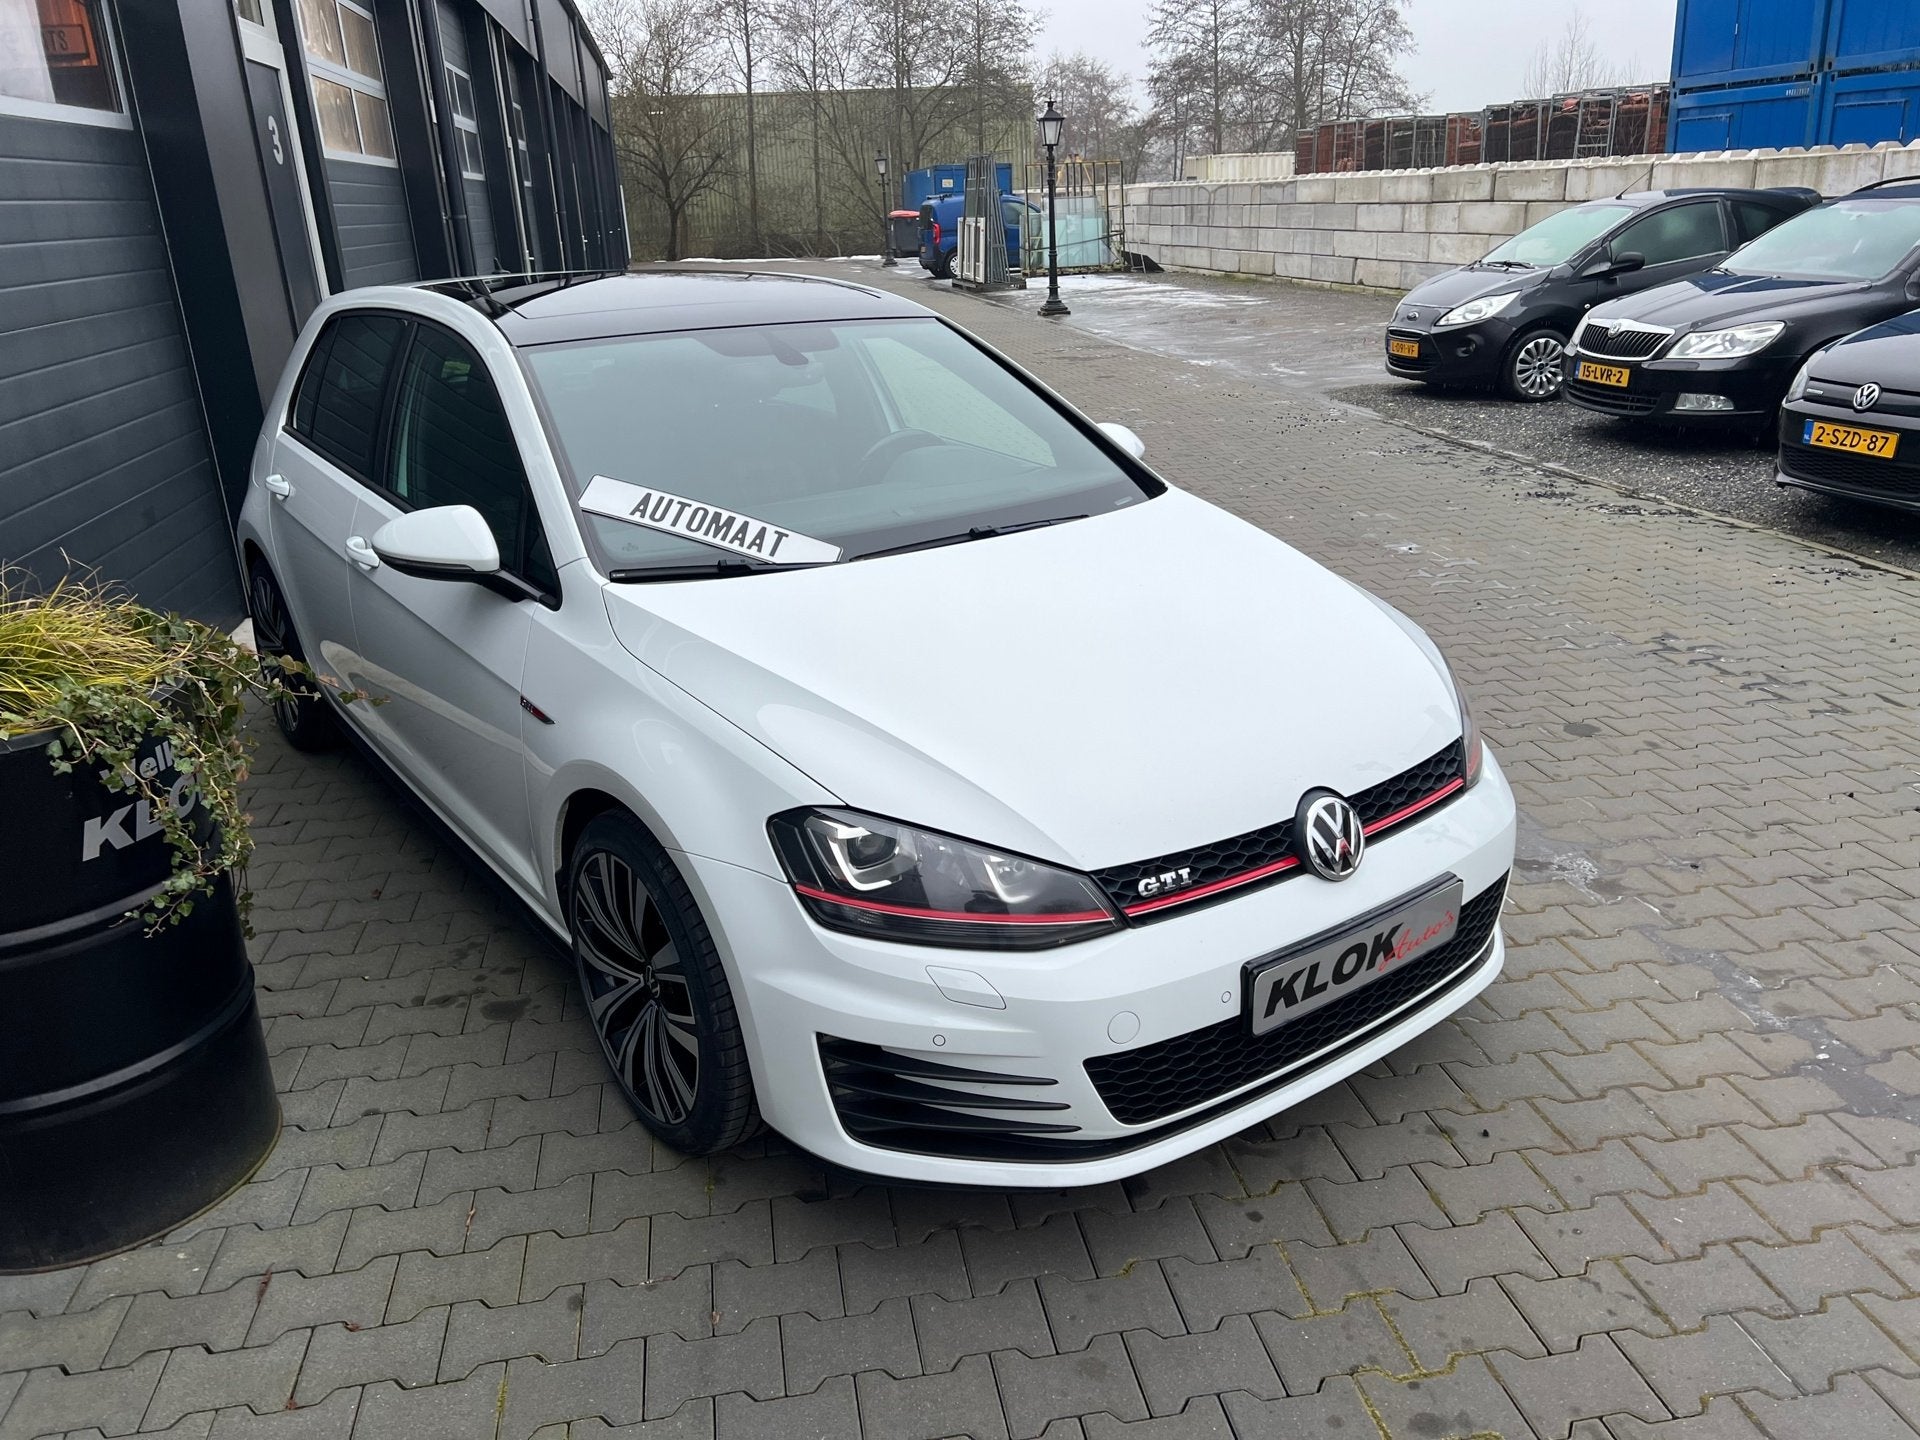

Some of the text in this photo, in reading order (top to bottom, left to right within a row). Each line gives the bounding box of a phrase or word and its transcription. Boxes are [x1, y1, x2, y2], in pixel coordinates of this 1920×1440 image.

[268, 115, 283, 165] 3
[1582, 364, 1624, 384] 15-LVR-2
[1815, 426, 1890, 453] 2-SZD-87
[629, 492, 789, 557] AUTOMAAT
[83, 773, 204, 862] KLO
[1137, 867, 1193, 898] GTI
[1263, 922, 1404, 1018] KLOK
